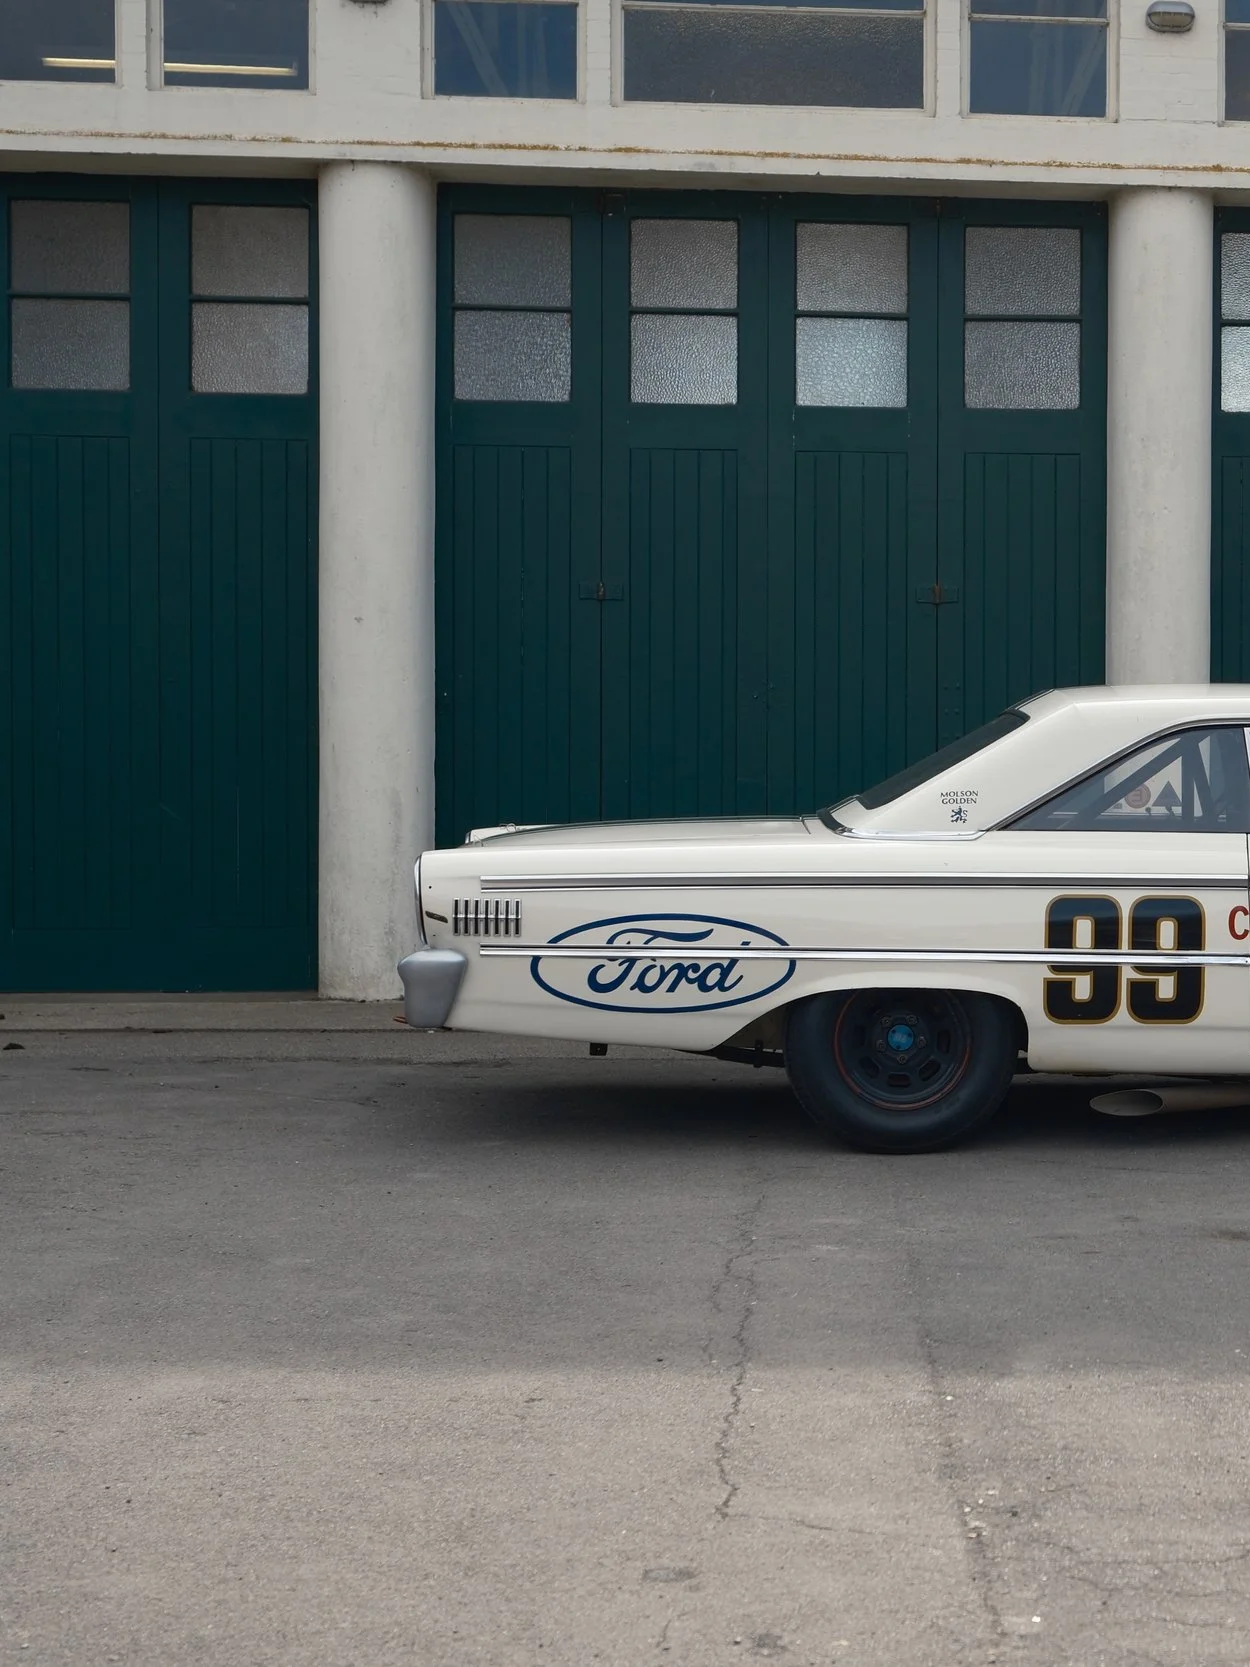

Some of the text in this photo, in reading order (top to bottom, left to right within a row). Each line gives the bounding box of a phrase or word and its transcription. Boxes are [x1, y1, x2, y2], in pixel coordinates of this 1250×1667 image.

[940, 790, 979, 798] MOLSON
[587, 928, 752, 994] Ford
[1043, 894, 1206, 1025] 99
